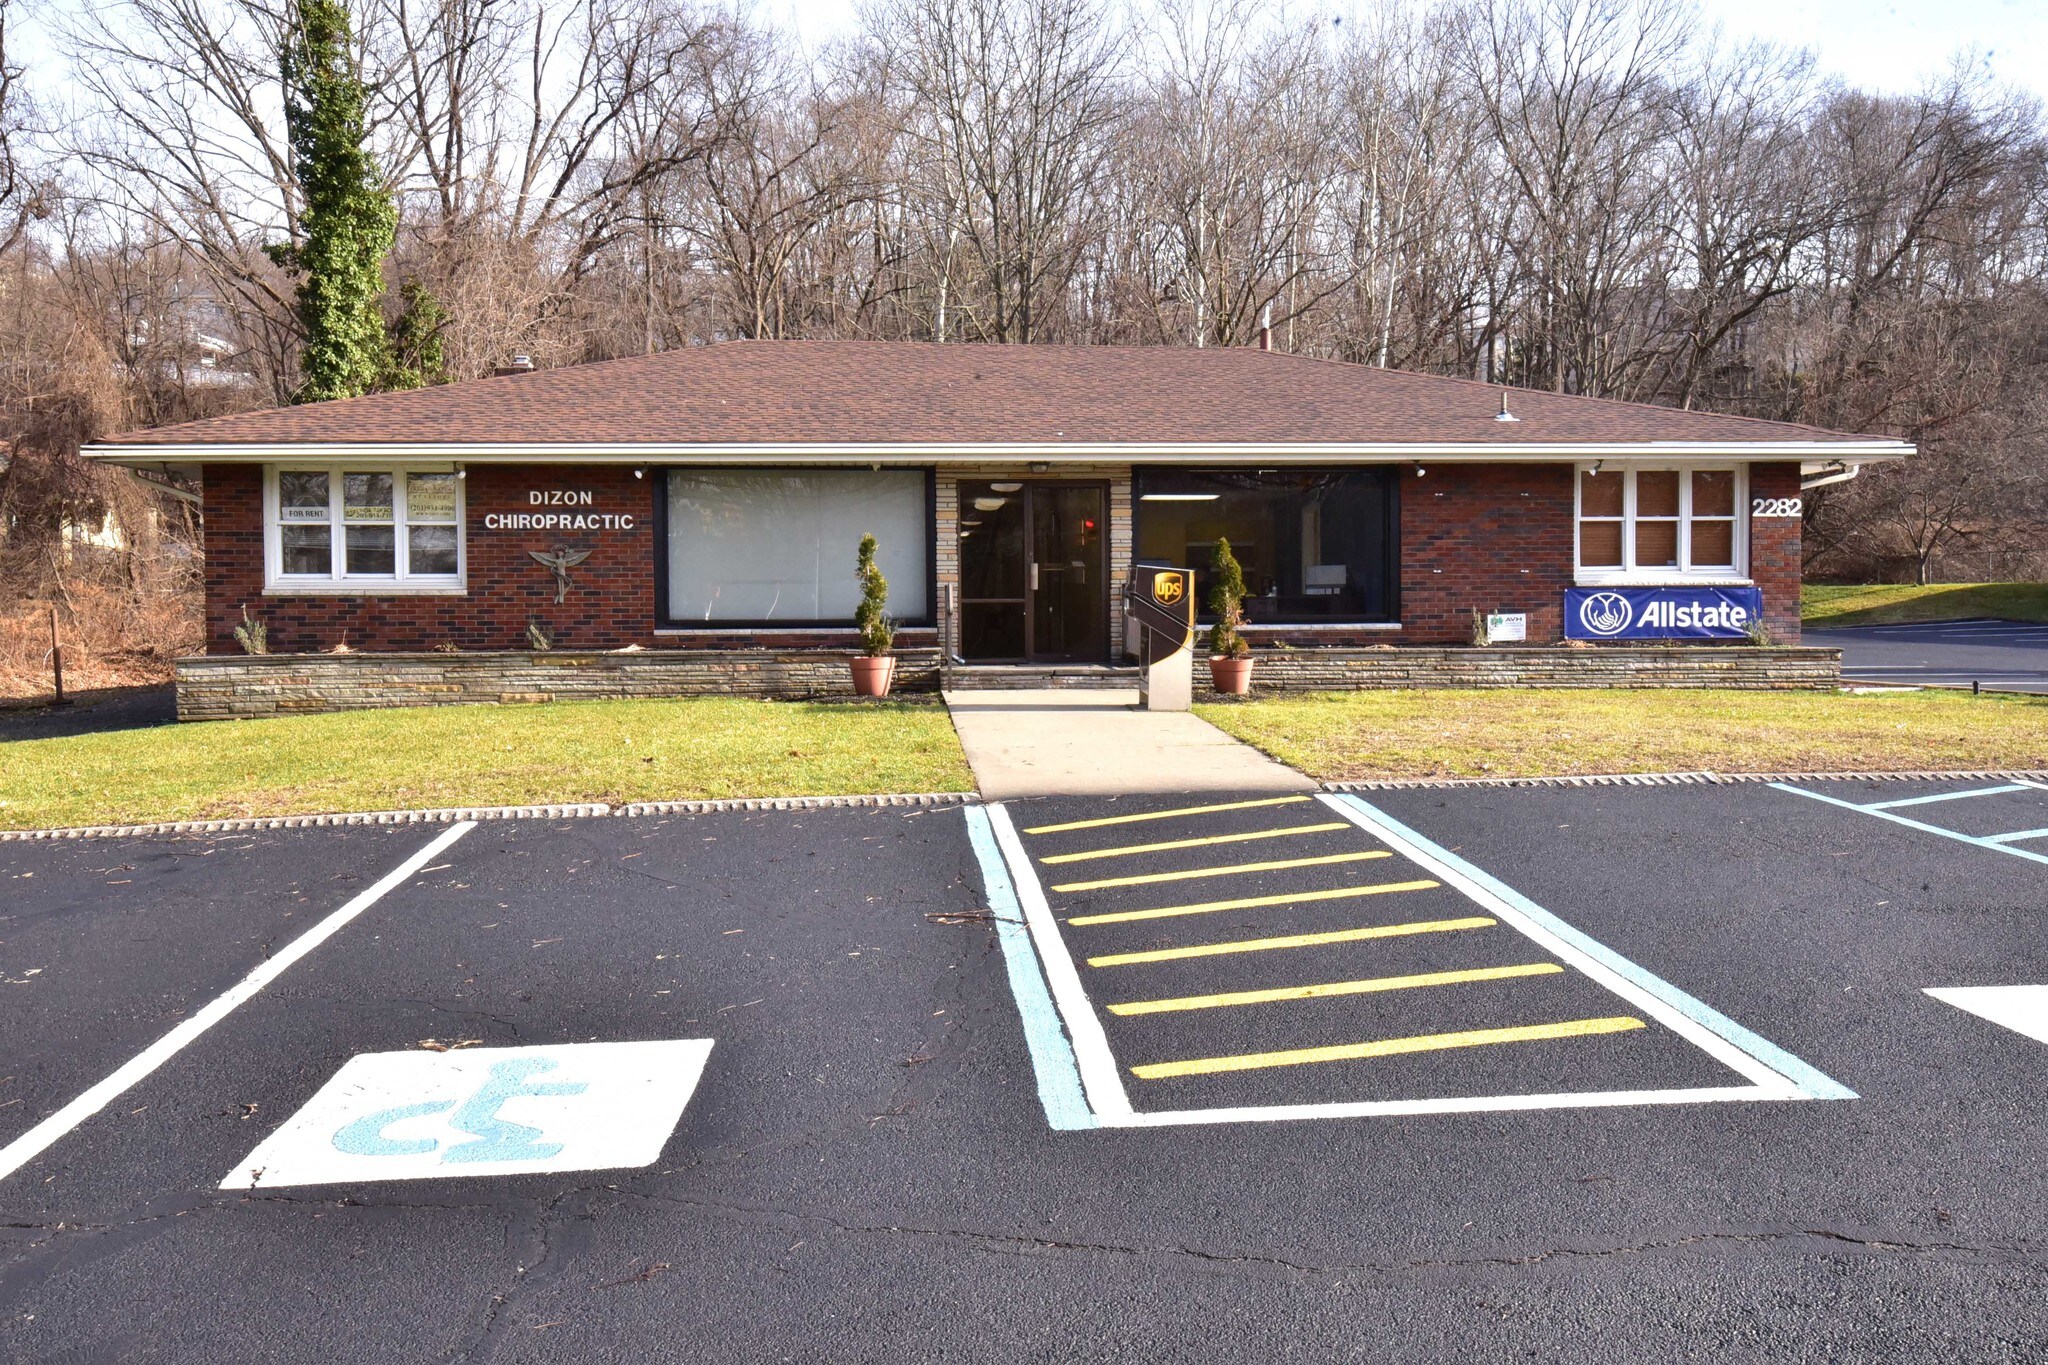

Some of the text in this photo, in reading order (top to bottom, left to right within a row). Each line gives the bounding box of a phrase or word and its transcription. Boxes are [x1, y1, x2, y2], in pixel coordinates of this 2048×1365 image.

[529, 490, 592, 505] DIZON
[1752, 498, 1803, 517] 2282
[484, 514, 635, 529] CHIROPRACTIC
[1157, 581, 1181, 600] ups
[1637, 601, 1747, 627] Allstate
